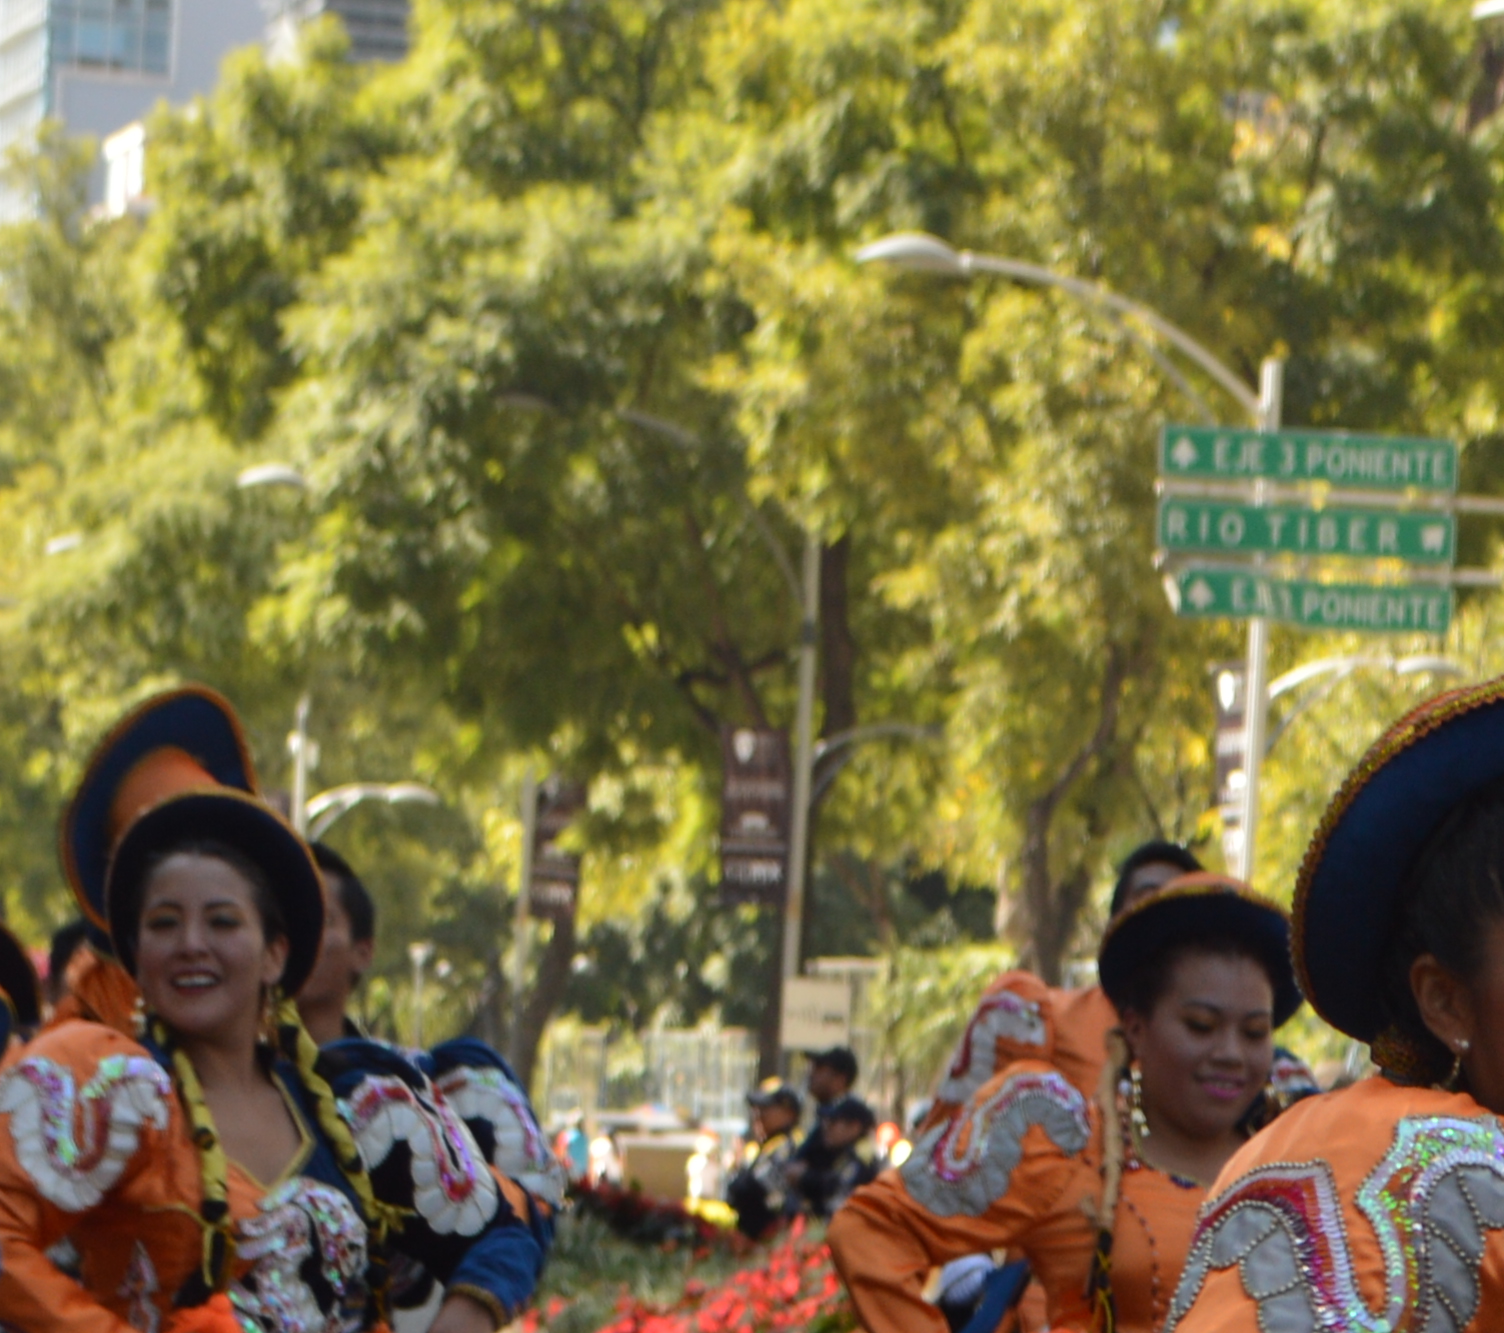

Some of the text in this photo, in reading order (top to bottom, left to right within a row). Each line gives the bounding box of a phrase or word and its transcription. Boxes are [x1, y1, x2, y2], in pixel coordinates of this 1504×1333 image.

[1214, 438, 1265, 473] EJE
[1306, 443, 1446, 479] PONIENTE
[1167, 508, 1400, 551] RIO TIBER
[1303, 588, 1442, 627] PONIENTE
